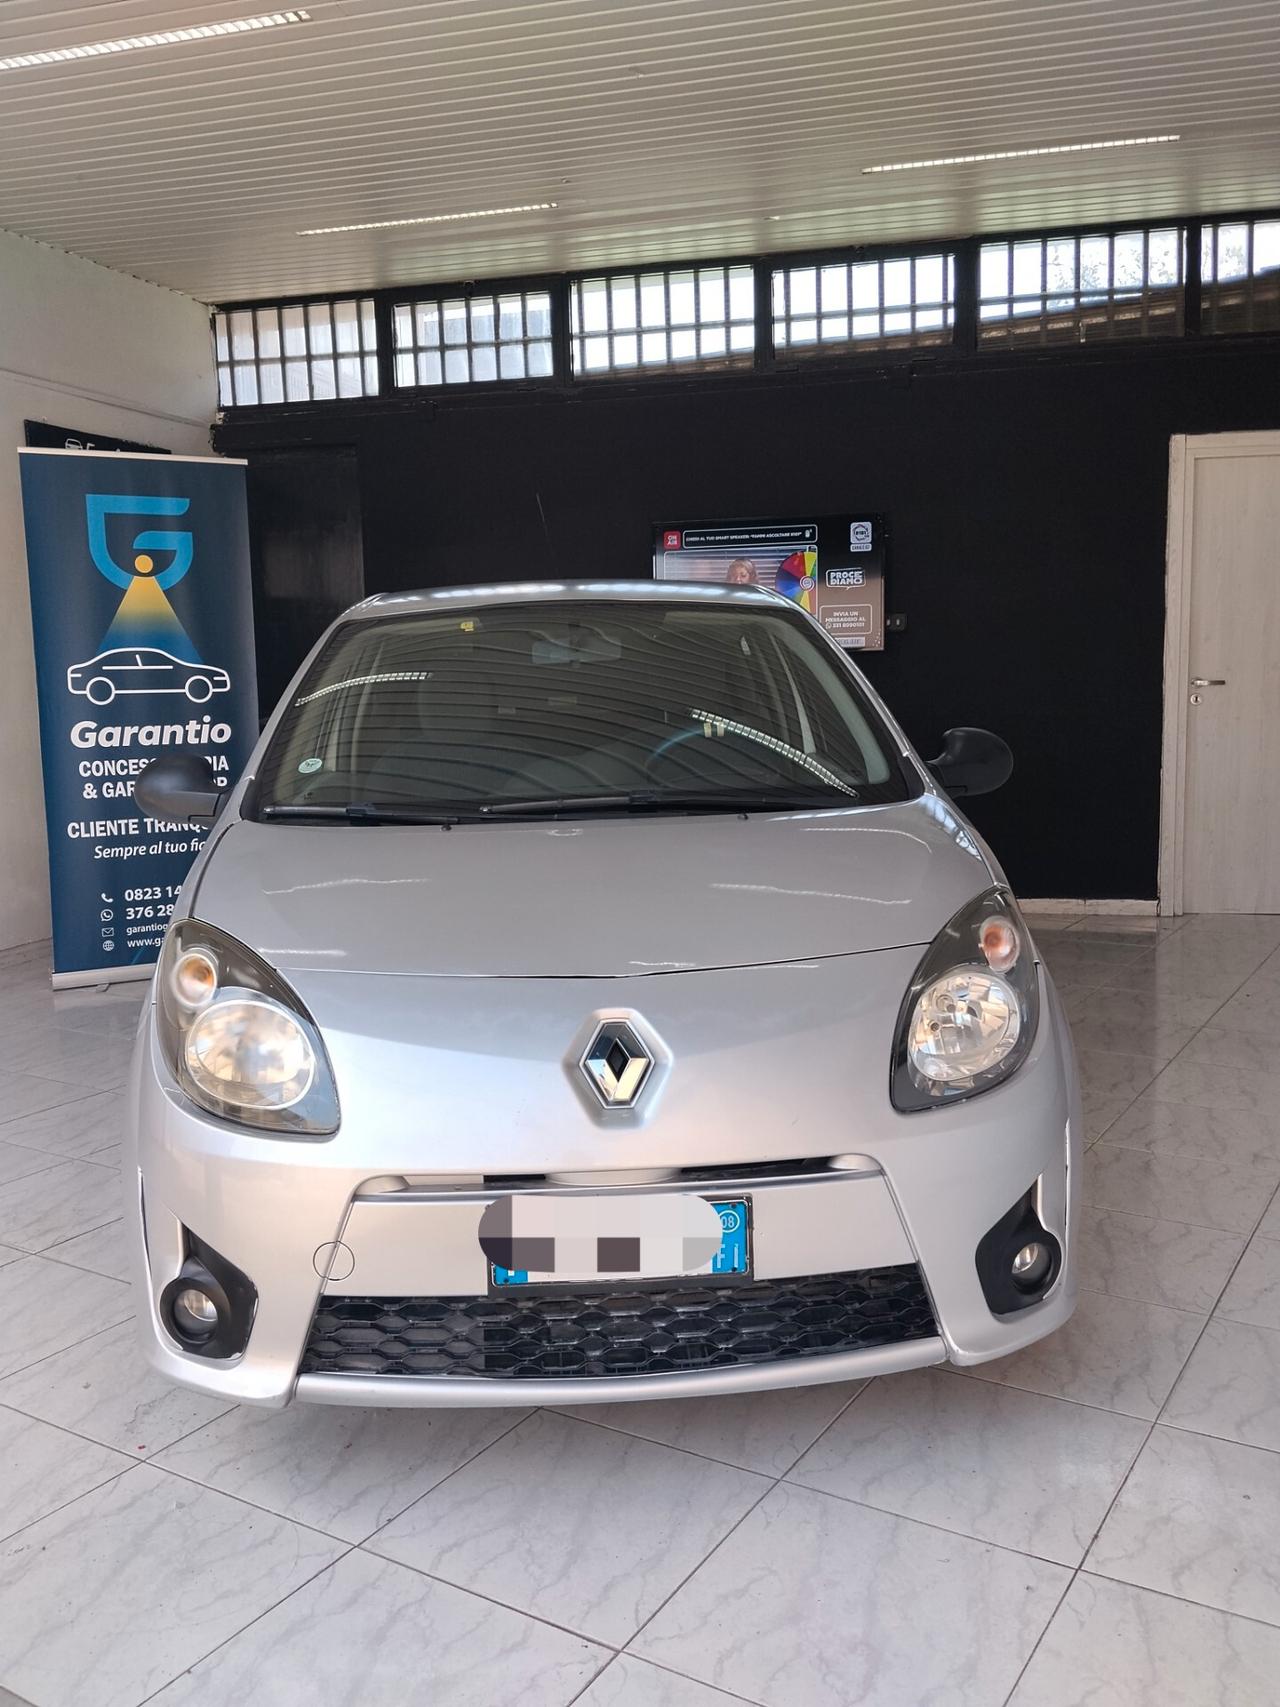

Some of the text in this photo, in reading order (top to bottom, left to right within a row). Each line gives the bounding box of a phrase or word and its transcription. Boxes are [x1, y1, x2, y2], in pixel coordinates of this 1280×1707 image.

[70, 715, 232, 748] Garantio
[82, 783, 98, 799] &
[67, 818, 139, 838] CLIENTE
[94, 845, 147, 860] Sempre
[149, 841, 163, 855] al
[165, 842, 187, 854] tuo
[124, 886, 162, 901] 0823
[125, 906, 154, 920] 376
[721, 1215, 735, 1228] 08
